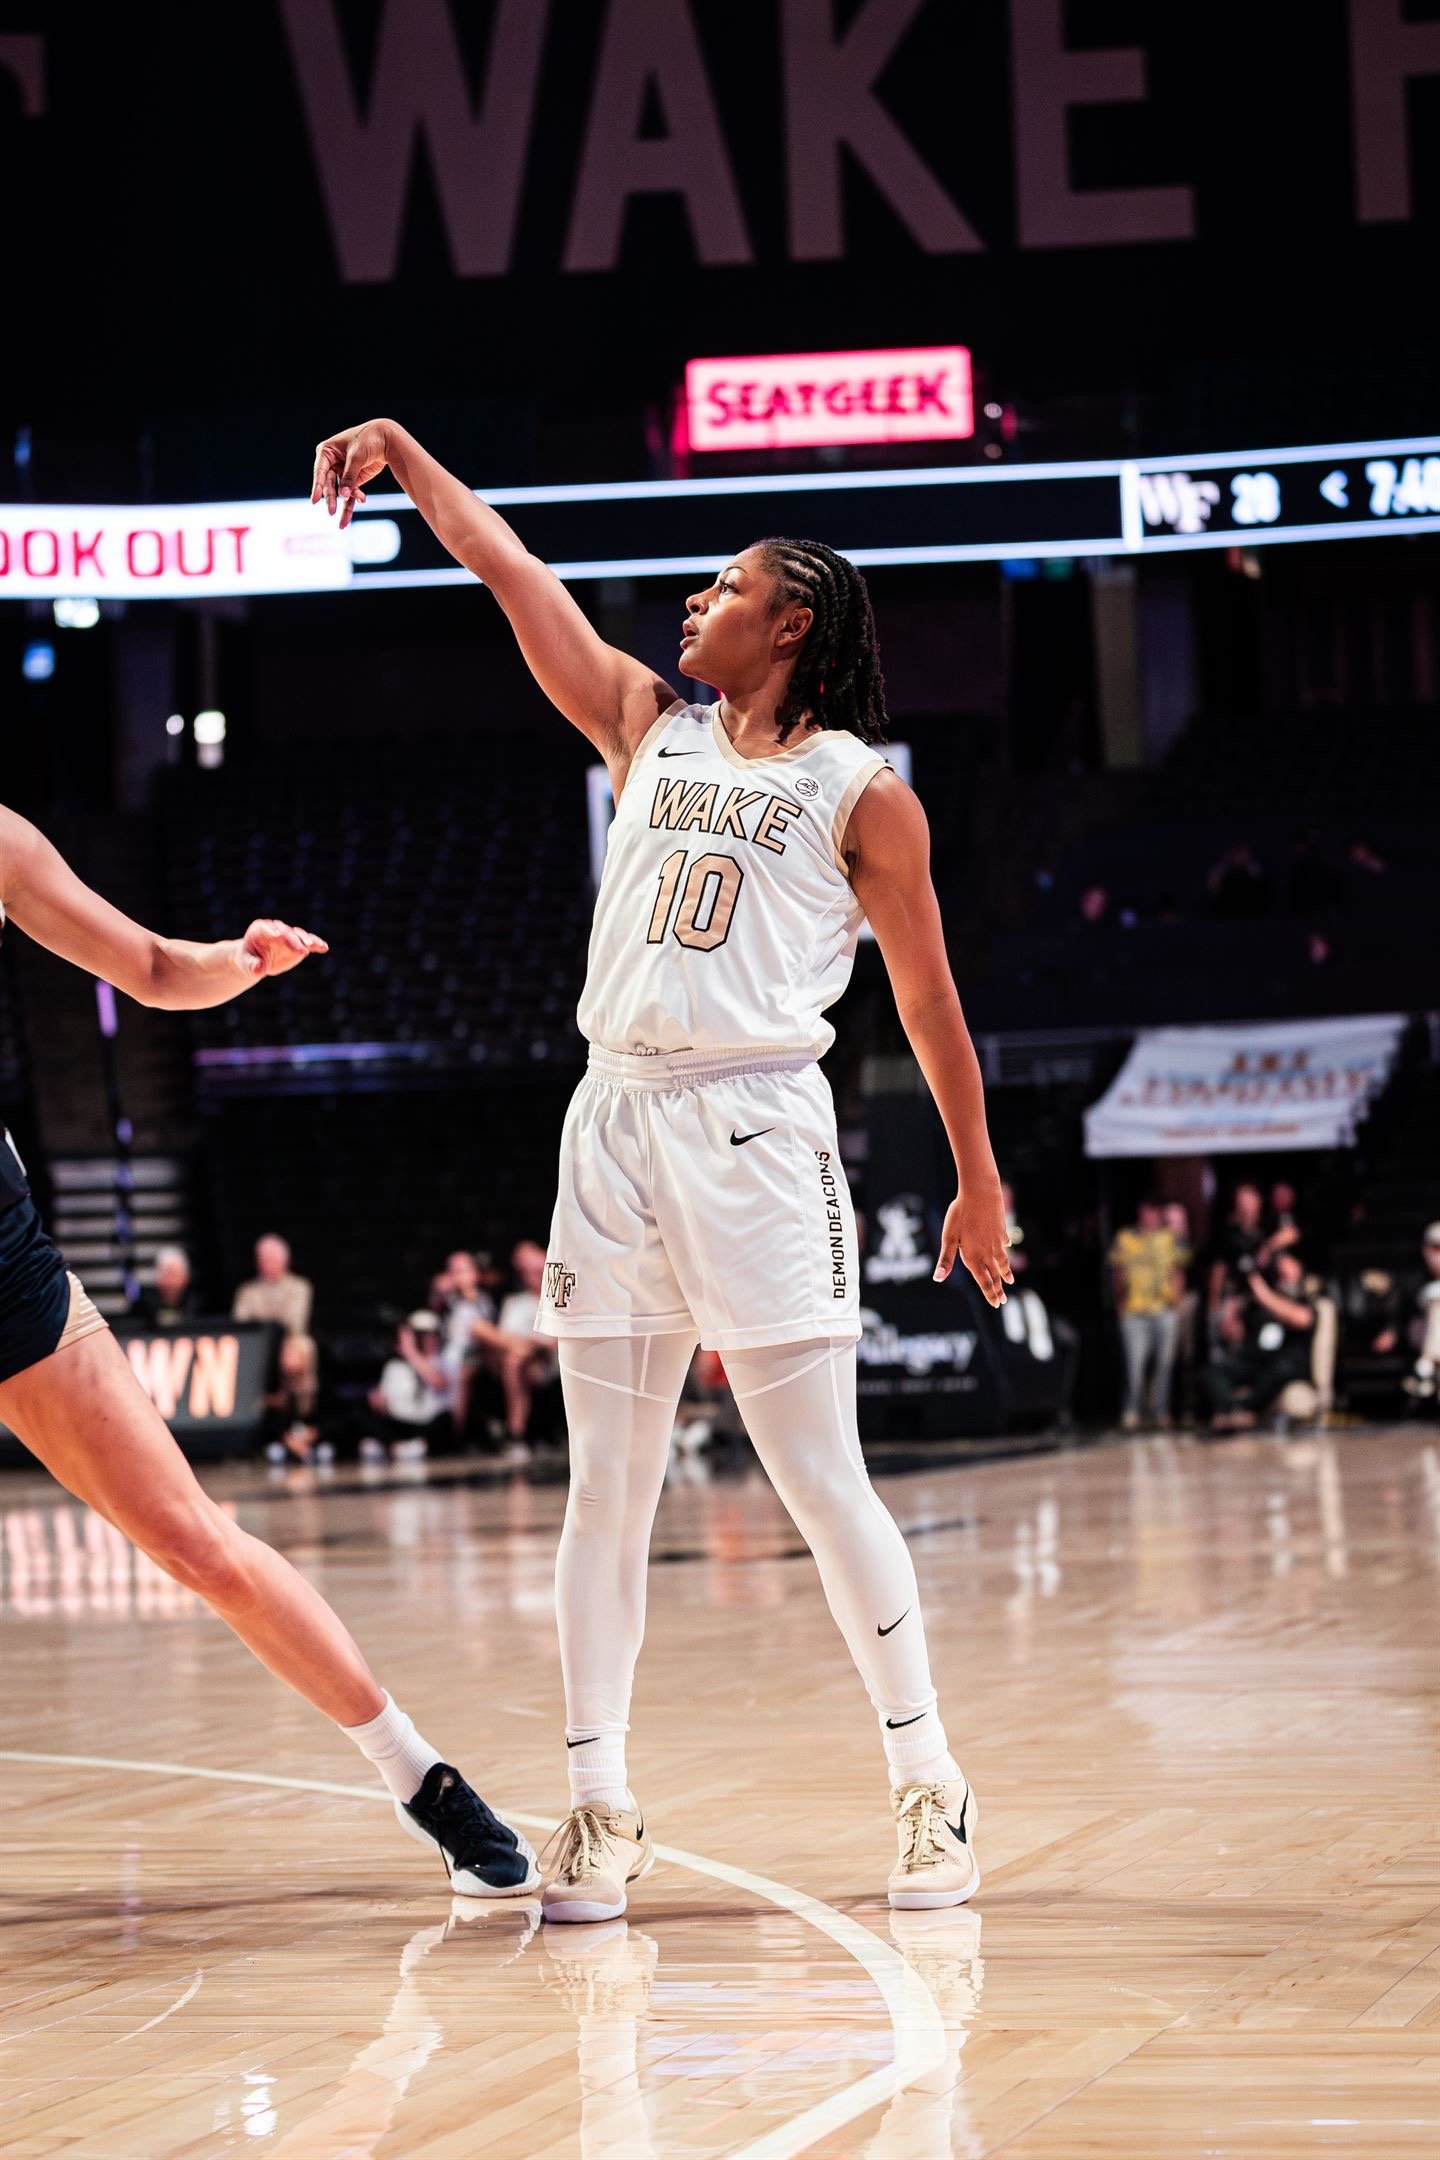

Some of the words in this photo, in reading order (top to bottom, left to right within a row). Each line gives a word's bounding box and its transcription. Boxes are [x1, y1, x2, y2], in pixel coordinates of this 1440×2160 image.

[280, 0, 1195, 283] WAKE
[707, 367, 950, 429] SEATGEEK
[0, 530, 105, 578] OK
[127, 526, 250, 578] OUT
[649, 778, 803, 856] WAKE
[646, 849, 745, 953] 10
[814, 1150, 843, 1233] DEACONS
[545, 1262, 576, 1308] WF
[829, 1237, 847, 1299] DEMON
